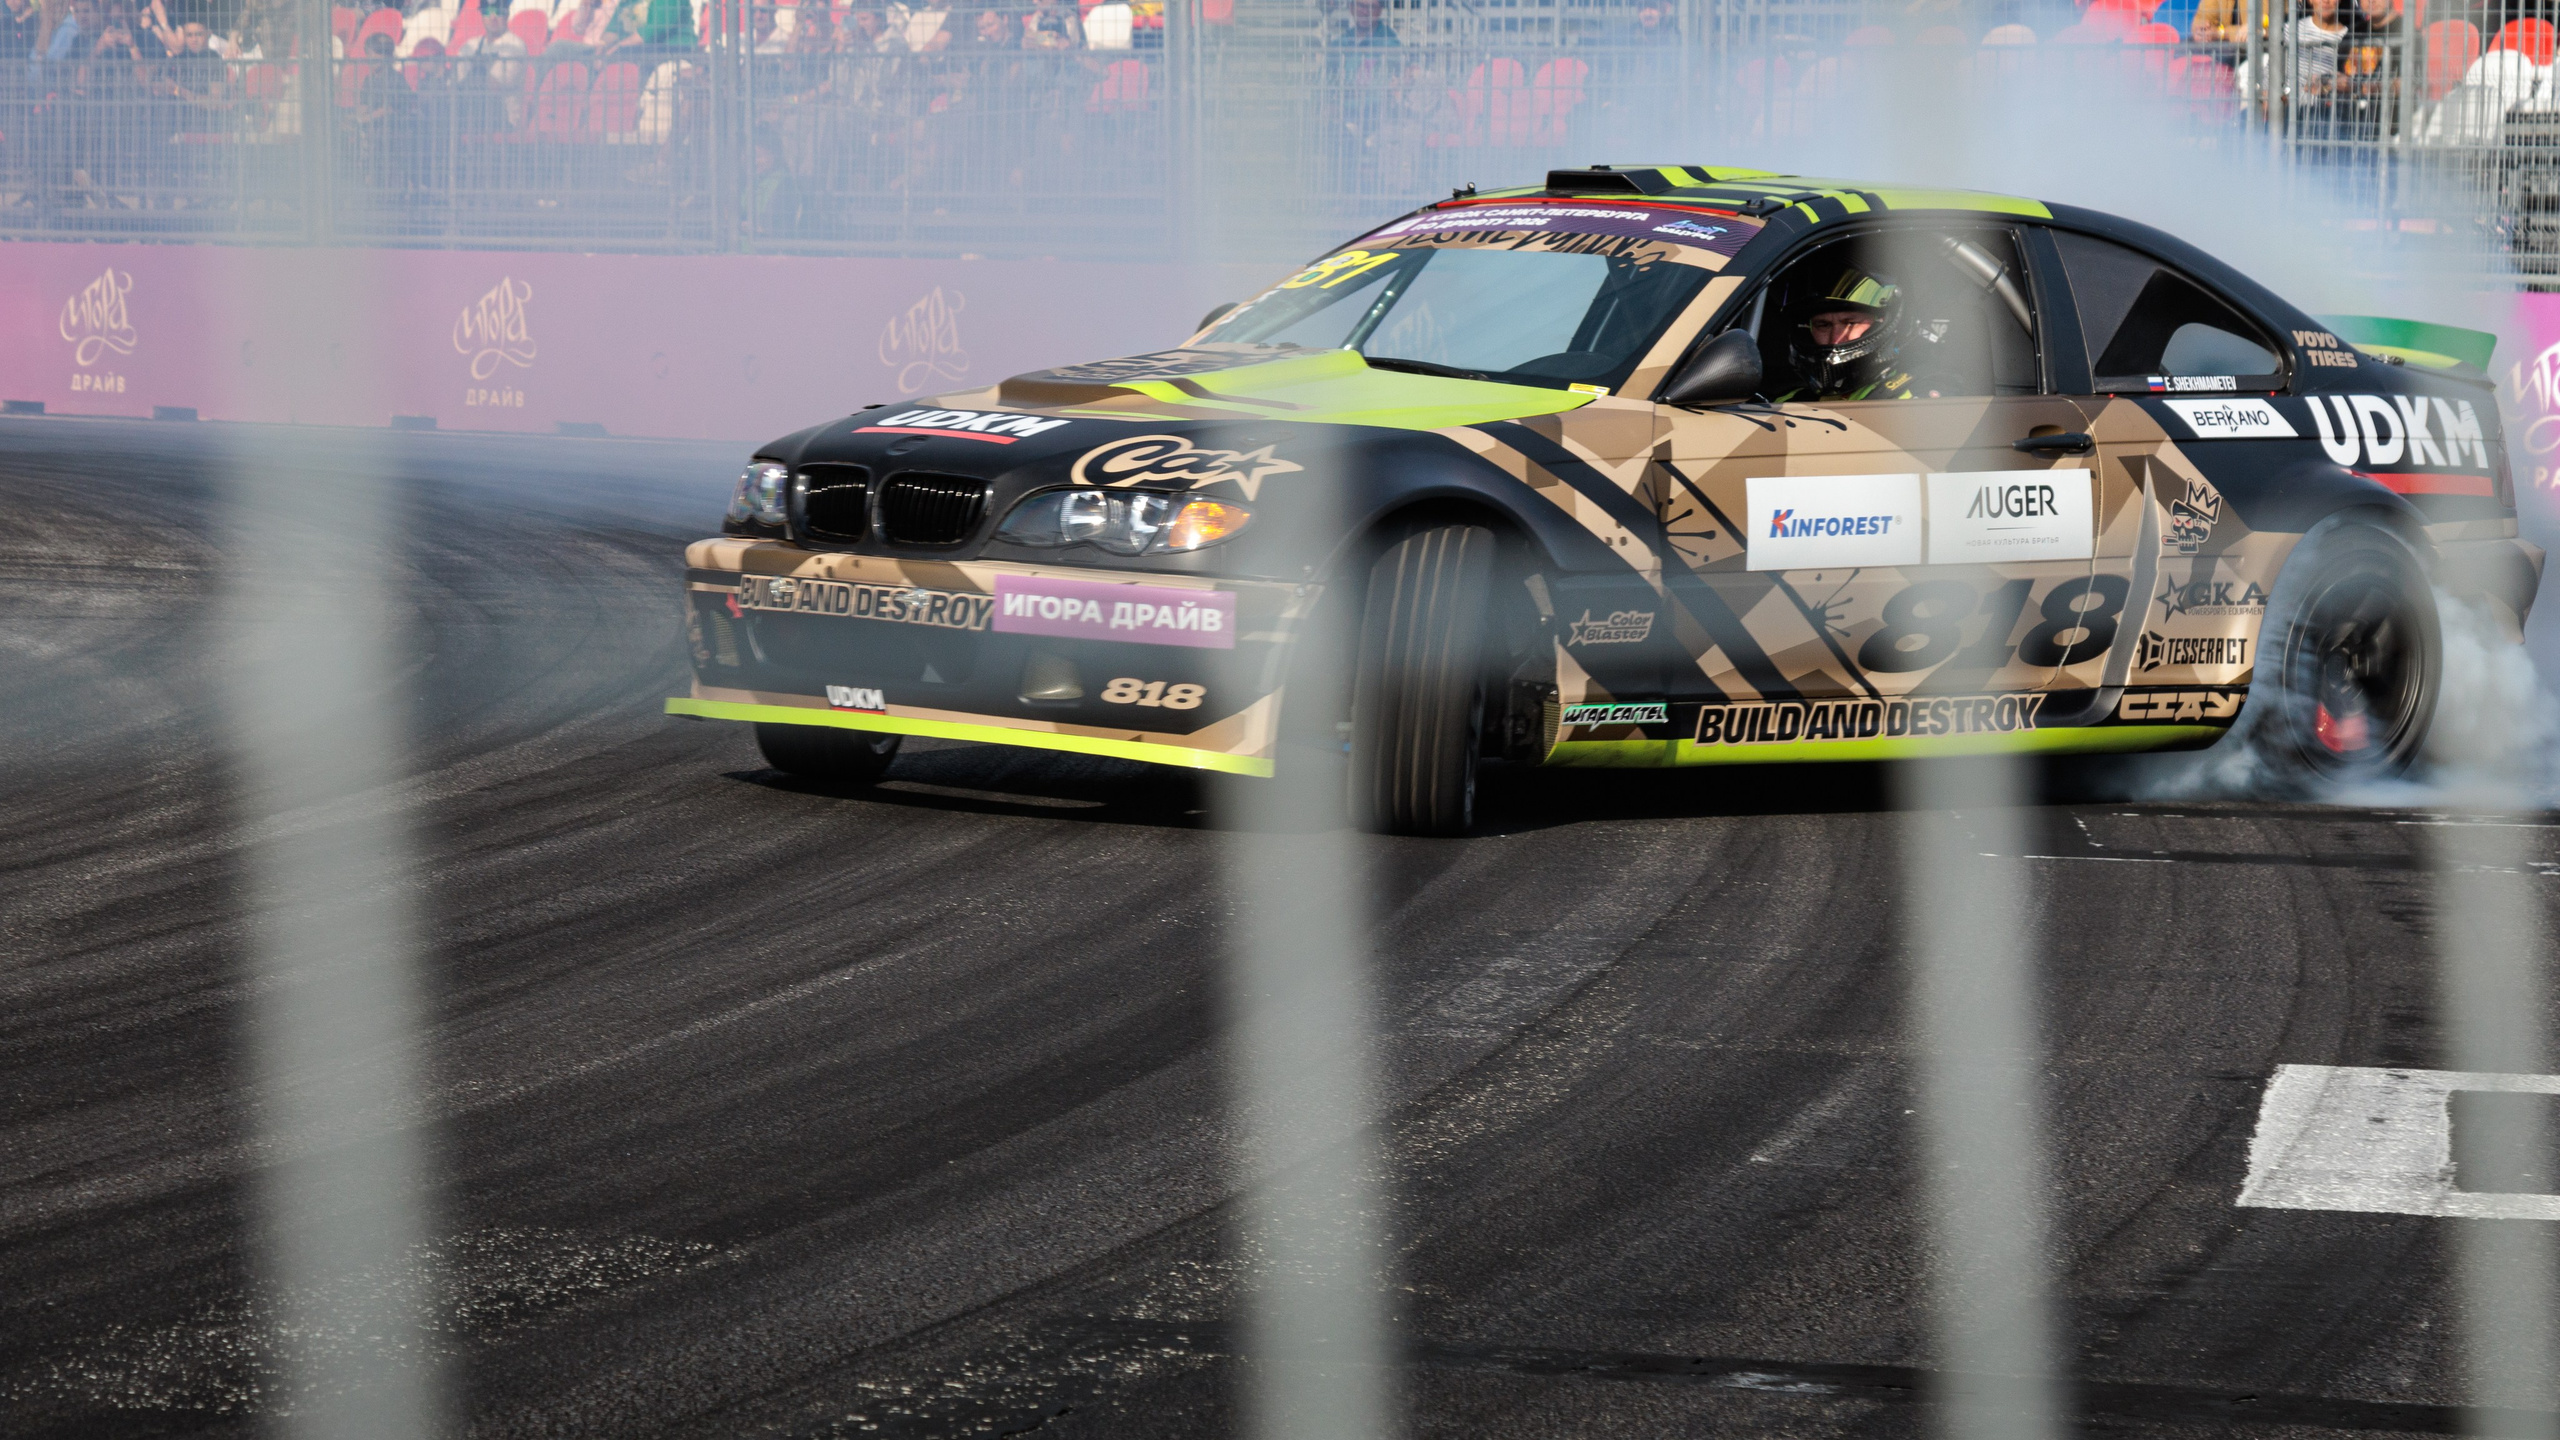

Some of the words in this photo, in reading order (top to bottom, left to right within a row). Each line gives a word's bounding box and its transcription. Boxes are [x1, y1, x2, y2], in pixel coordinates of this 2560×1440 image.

[1435, 217, 1508, 229] ДРИФТУ
[1507, 217, 1552, 227] 2026
[1485, 207, 1651, 222] САНКТ-ПЕТЕРБУРГА
[2291, 330, 2339, 349] YOYO
[2307, 349, 2359, 369] TIRES
[69, 372, 127, 394] ДРАЙВ
[2164, 377, 2174, 391] E.
[2175, 376, 2237, 391] SHEKHMAMETEV
[465, 386, 525, 408] ДРАЙВ
[875, 410, 1074, 440] UDKM
[2192, 406, 2270, 430] BERKANO
[2304, 395, 2489, 469] UDKM
[1966, 484, 2060, 519] AUGER
[1769, 509, 1893, 538] KINFOREST
[1994, 537, 2030, 546] КУЛЬТУРА
[2032, 536, 2060, 545] БРИТЬЯ
[797, 579, 852, 617] AND
[852, 585, 994, 631] DESTROY
[2187, 581, 2268, 606] GKA
[1002, 592, 1102, 624] ИГОРА
[1109, 600, 1223, 633] ДРАЙВ
[1609, 611, 1653, 627] Color
[2187, 606, 2227, 616] POWERSPORTS
[2228, 606, 2266, 616] EQUIPMENT
[1586, 627, 1647, 641] Blaster
[1858, 574, 2130, 673] 818
[2167, 637, 2248, 665] TESSERACT
[825, 684, 886, 711] UDKM
[1100, 677, 1207, 710] 818
[1697, 703, 1804, 746] BUILD
[1804, 699, 1884, 743] AND
[1886, 694, 2045, 737] DESTROY
